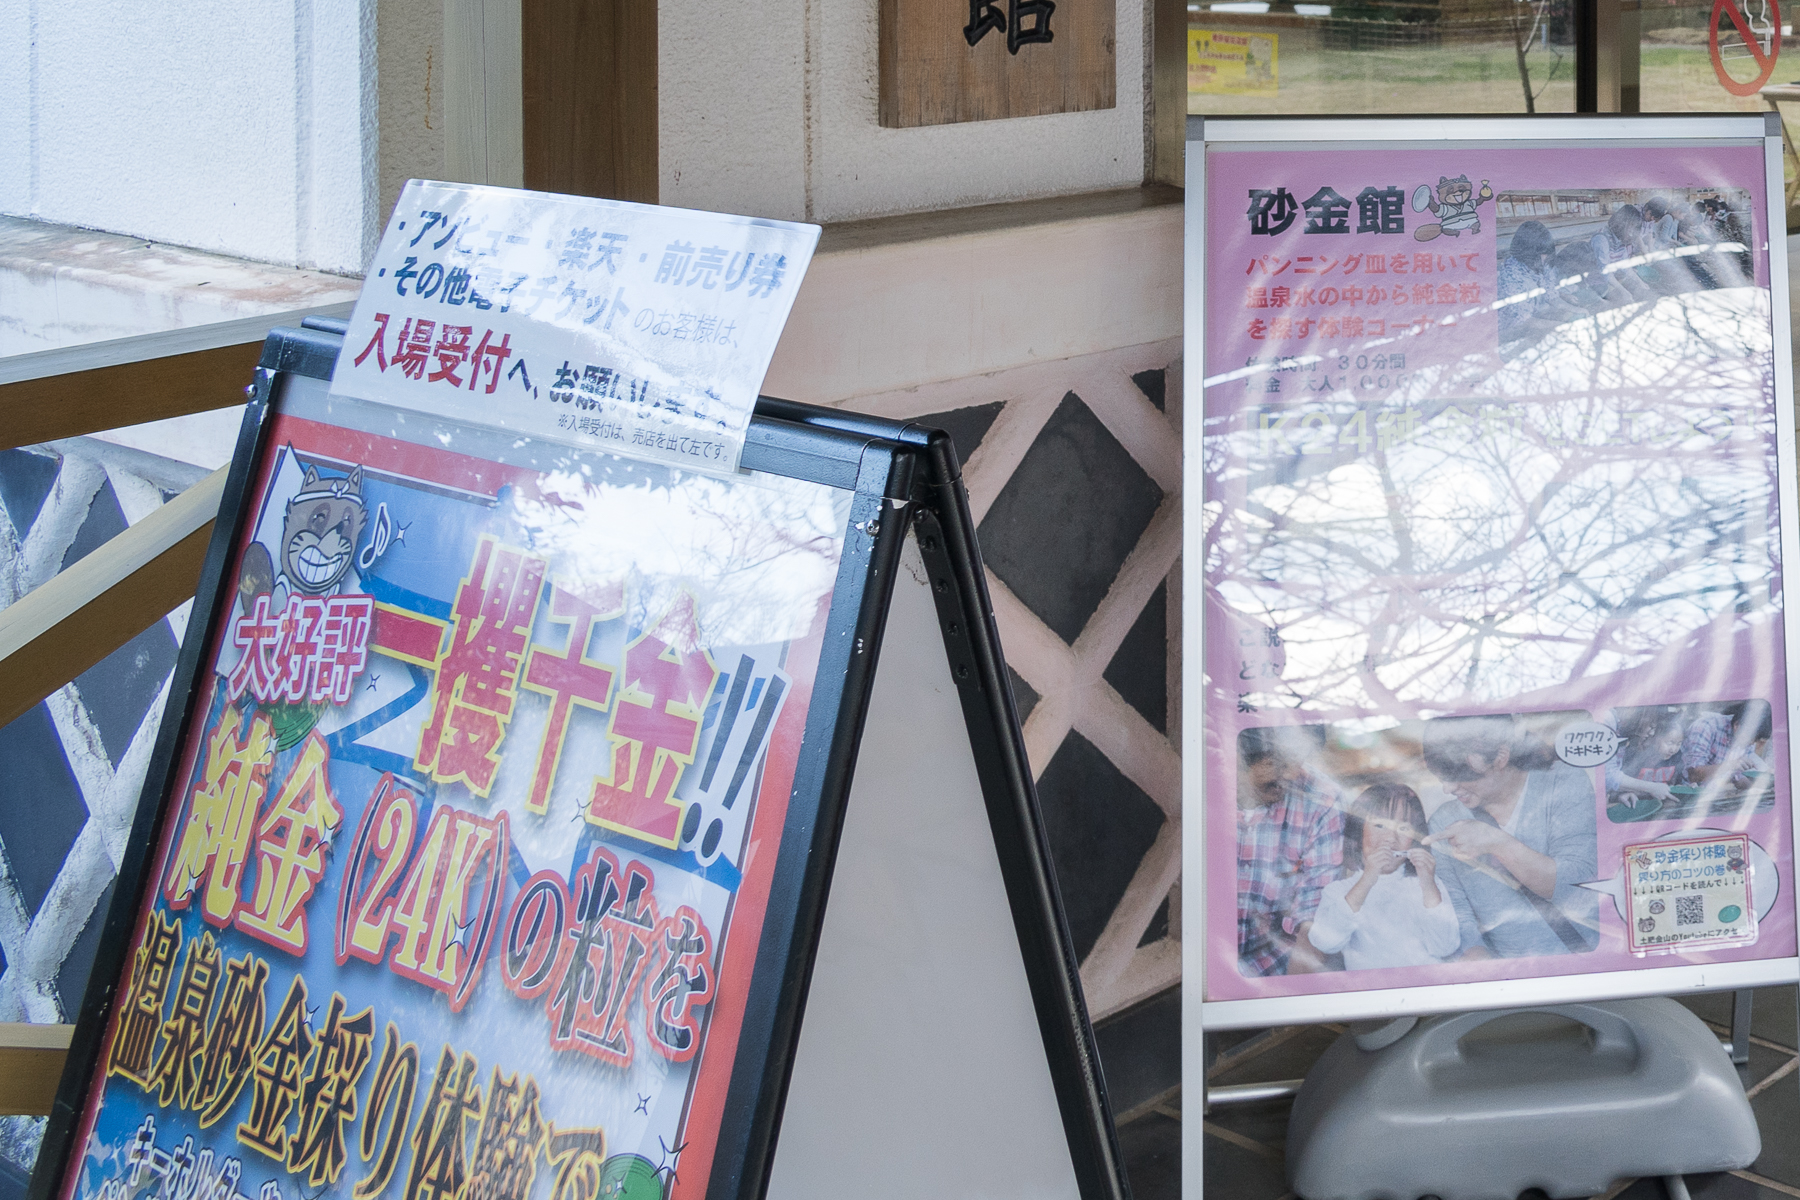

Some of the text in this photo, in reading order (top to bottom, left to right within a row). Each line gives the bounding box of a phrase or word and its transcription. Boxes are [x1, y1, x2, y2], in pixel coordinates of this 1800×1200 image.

[1246, 185, 1406, 238] 砂金館
[1245, 252, 1481, 277] パンニング皿を用いて
[1245, 281, 1482, 309] 温泉水の中から純金粒
[1246, 314, 1458, 340] を探す体験コーナー
[229, 594, 375, 702] 大好評
[1655, 845, 1727, 864] 砂金採り体験
